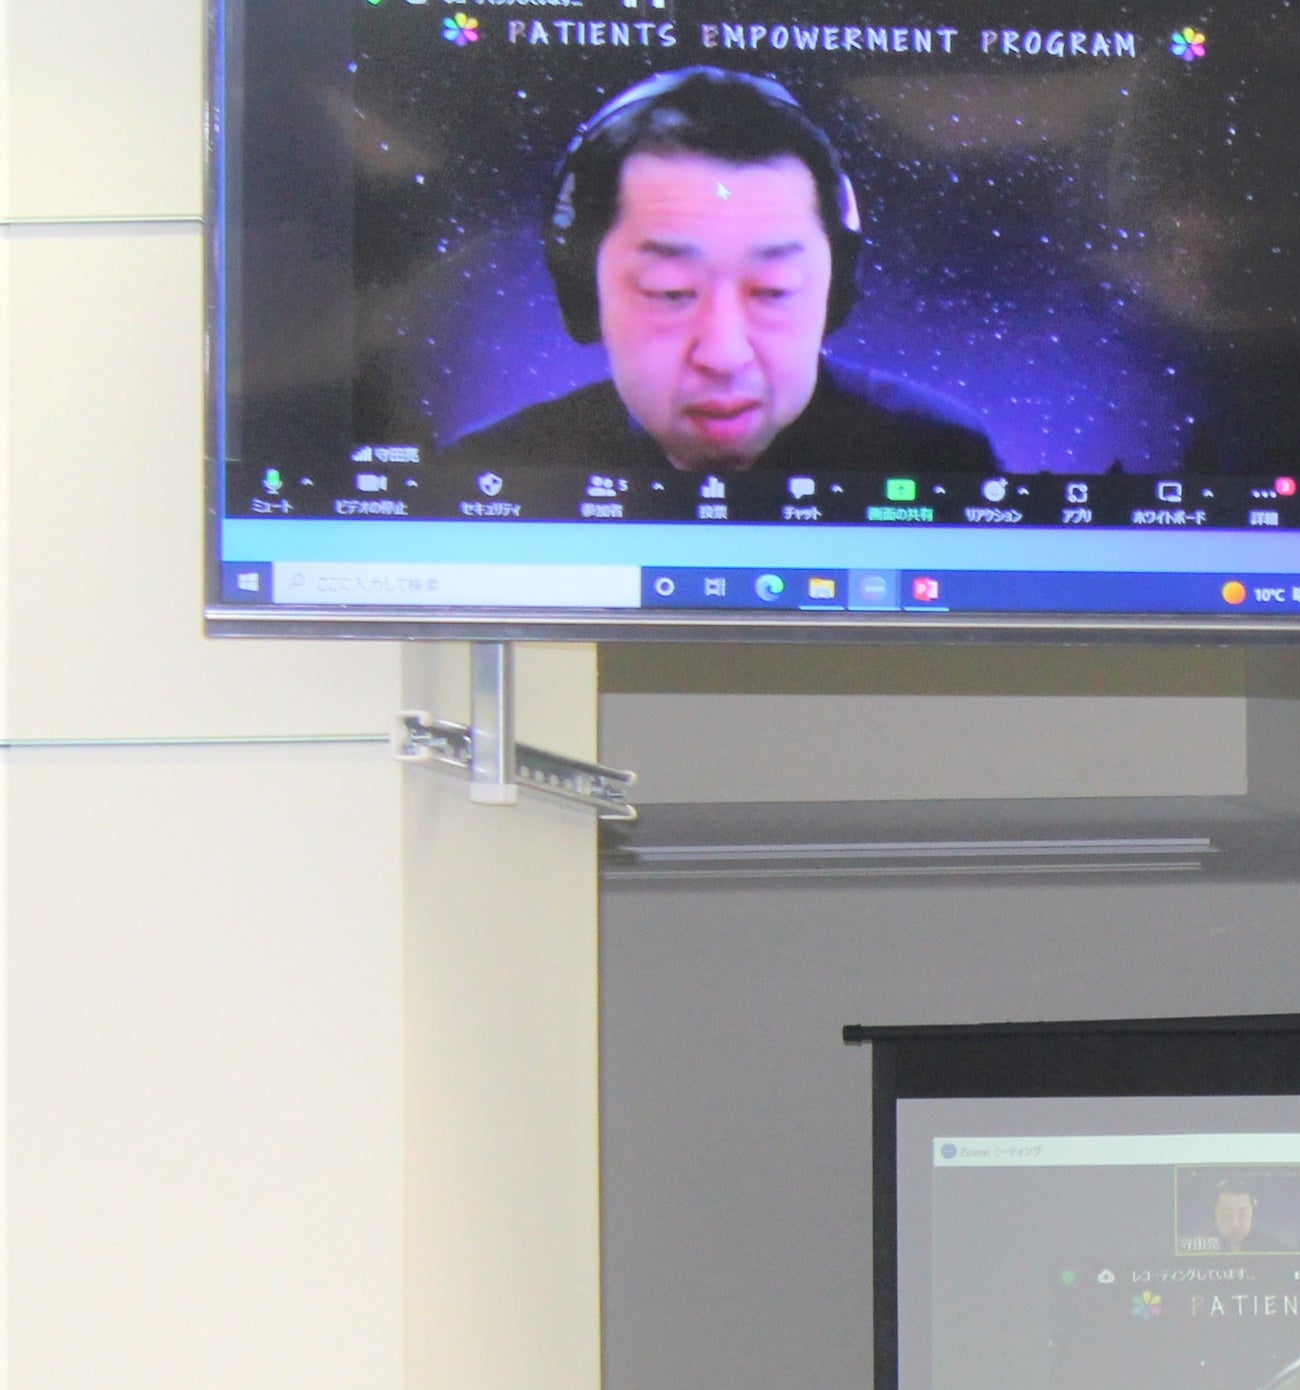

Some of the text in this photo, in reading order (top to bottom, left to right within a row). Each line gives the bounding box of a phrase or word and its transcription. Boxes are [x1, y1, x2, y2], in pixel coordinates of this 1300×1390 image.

[508, 20, 1135, 58] PATIENTS EMPOWERMENT PROGRAM
[252, 500, 293, 513] ミュート
[335, 500, 408, 515] ビデオの停止
[459, 501, 521, 517] セキュリティ
[782, 505, 822, 520] チャット
[868, 507, 934, 522] 画面の共有
[965, 508, 1022, 523] リアクション
[1062, 509, 1092, 523] アプリ
[1132, 510, 1206, 525] ホワイトボード
[1250, 510, 1278, 526] 詳細
[316, 577, 440, 592] ここに入力して検索
[959, 1147, 990, 1158] Zoom
